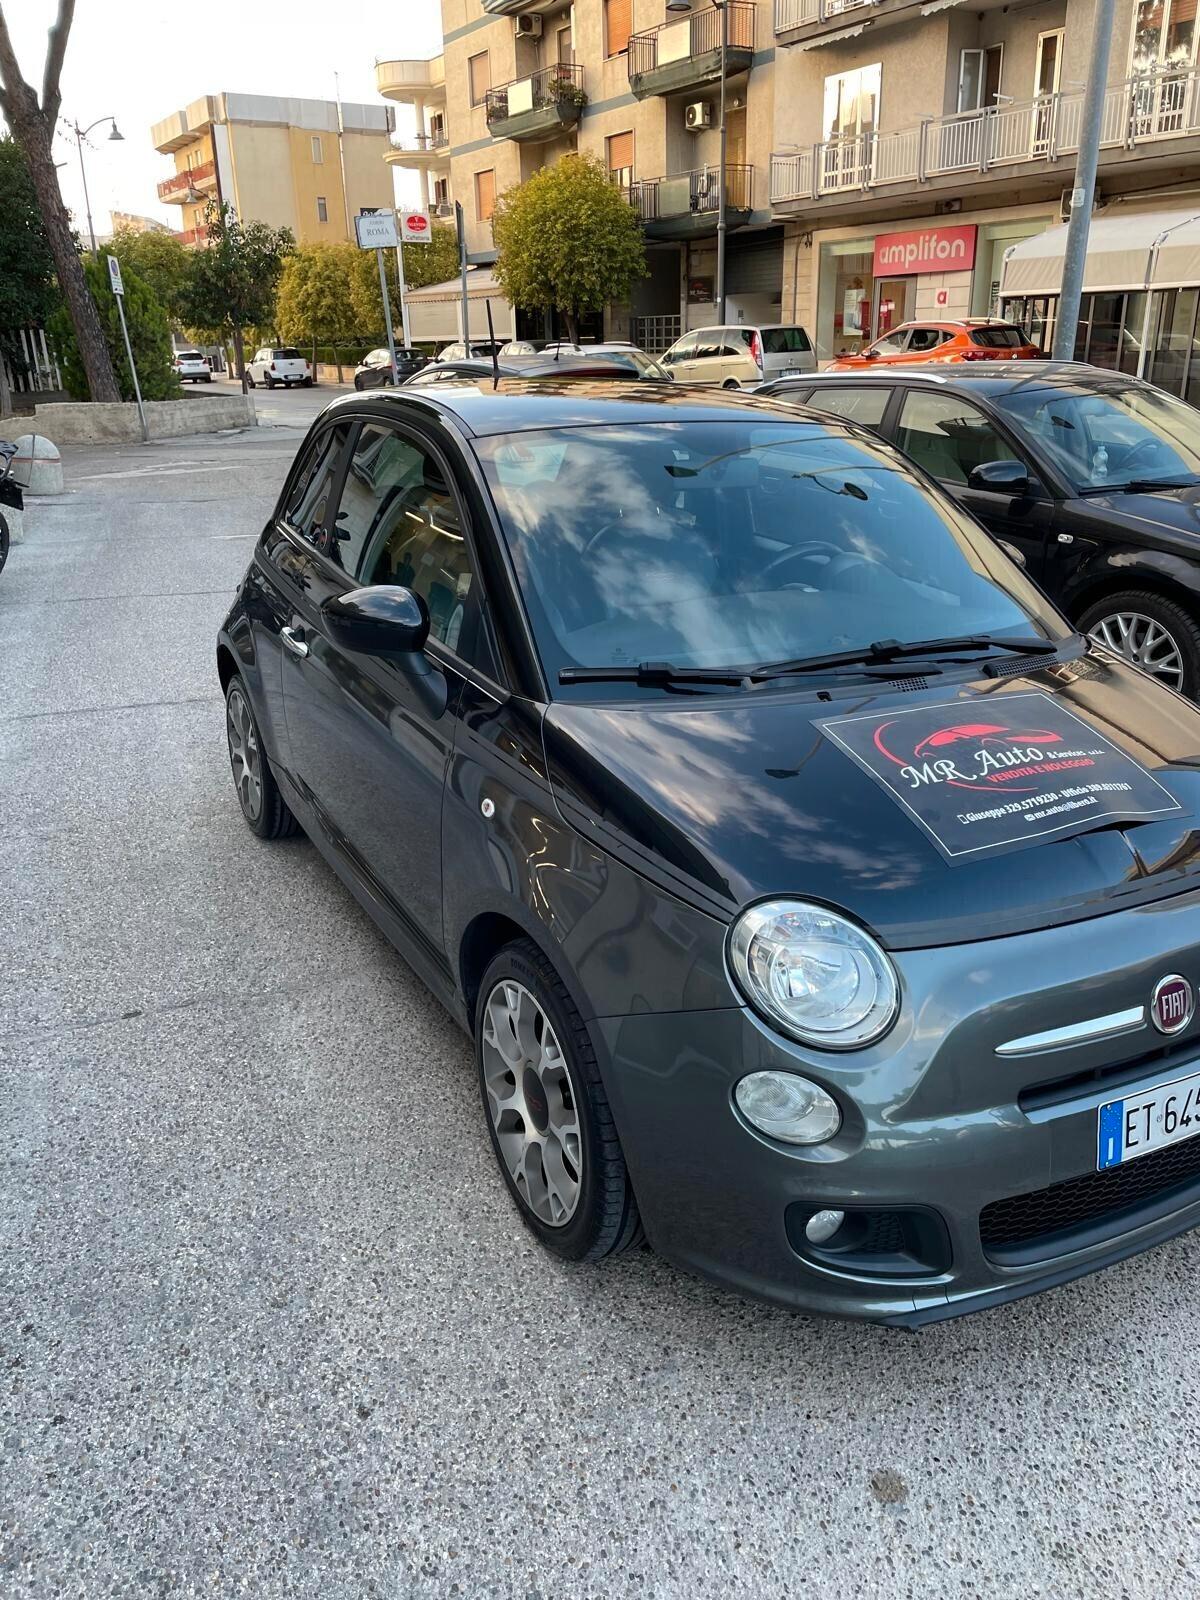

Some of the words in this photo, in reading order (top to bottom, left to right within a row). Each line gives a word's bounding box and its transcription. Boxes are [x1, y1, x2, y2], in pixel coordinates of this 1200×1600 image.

[366, 228, 390, 236] ROMA
[879, 234, 966, 268] amplifon
[937, 291, 947, 304] a
[900, 760, 977, 788] MR
[974, 746, 1044, 776] Auto
[985, 766, 1037, 783] VENDITA
[1036, 765, 1045, 773] E
[1043, 758, 1096, 772] NOLEGGIO
[966, 807, 1008, 822] Giuseppe
[1003, 792, 1059, 813] 329.5719230
[1060, 786, 1090, 798] Ufficio
[1033, 796, 1099, 819] mr.auto@libero.it
[1161, 989, 1185, 1021] FIAT
[1125, 1102, 1156, 1149] ET
